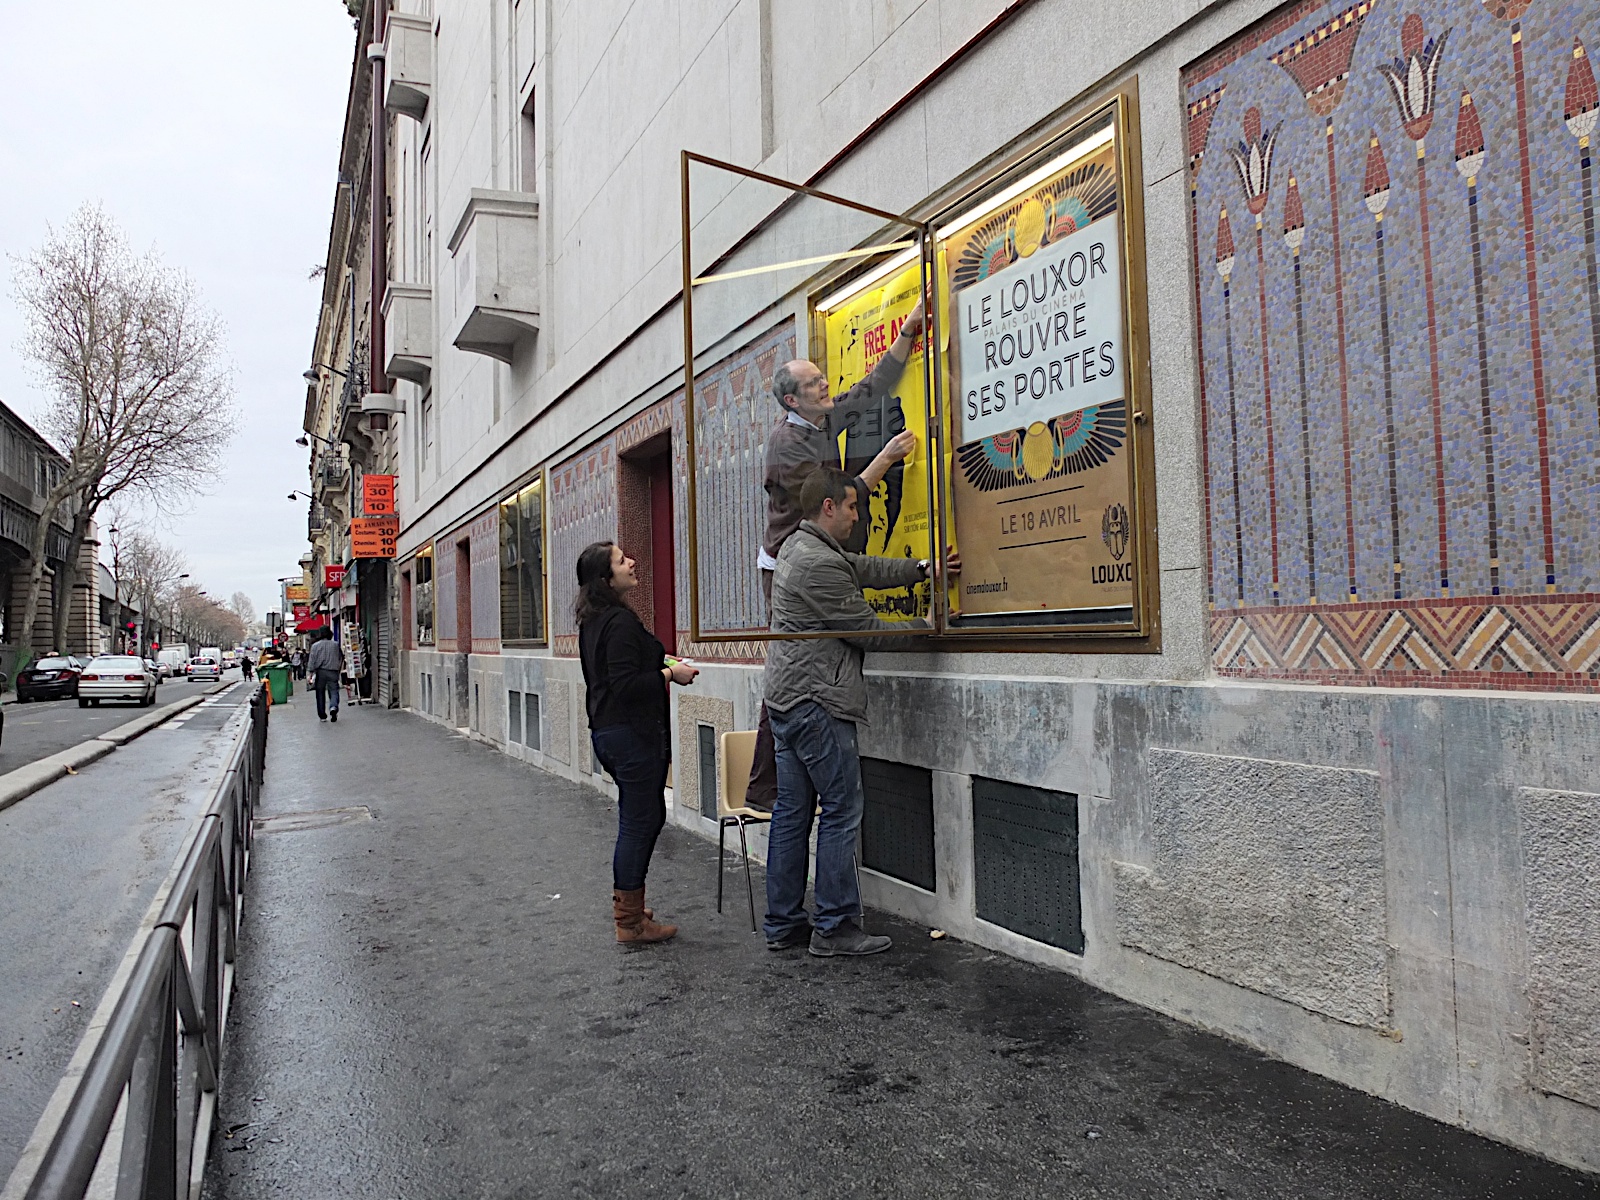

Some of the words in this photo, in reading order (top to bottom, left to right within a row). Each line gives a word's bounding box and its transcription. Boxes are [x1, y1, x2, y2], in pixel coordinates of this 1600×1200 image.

[968, 295, 992, 334] LE
[1000, 242, 1107, 319] LOUXOR
[864, 324, 887, 359] FREE
[984, 320, 1018, 340] PALAIS
[1022, 310, 1037, 325] DU
[985, 302, 1087, 372] ROUVRE
[967, 380, 1007, 421] SES
[1015, 341, 1115, 406] PORTES
[1001, 514, 1018, 535] LE
[1021, 511, 1035, 531] 18
[1039, 503, 1082, 529] AVRIL
[1091, 562, 1132, 584] LOUXO
